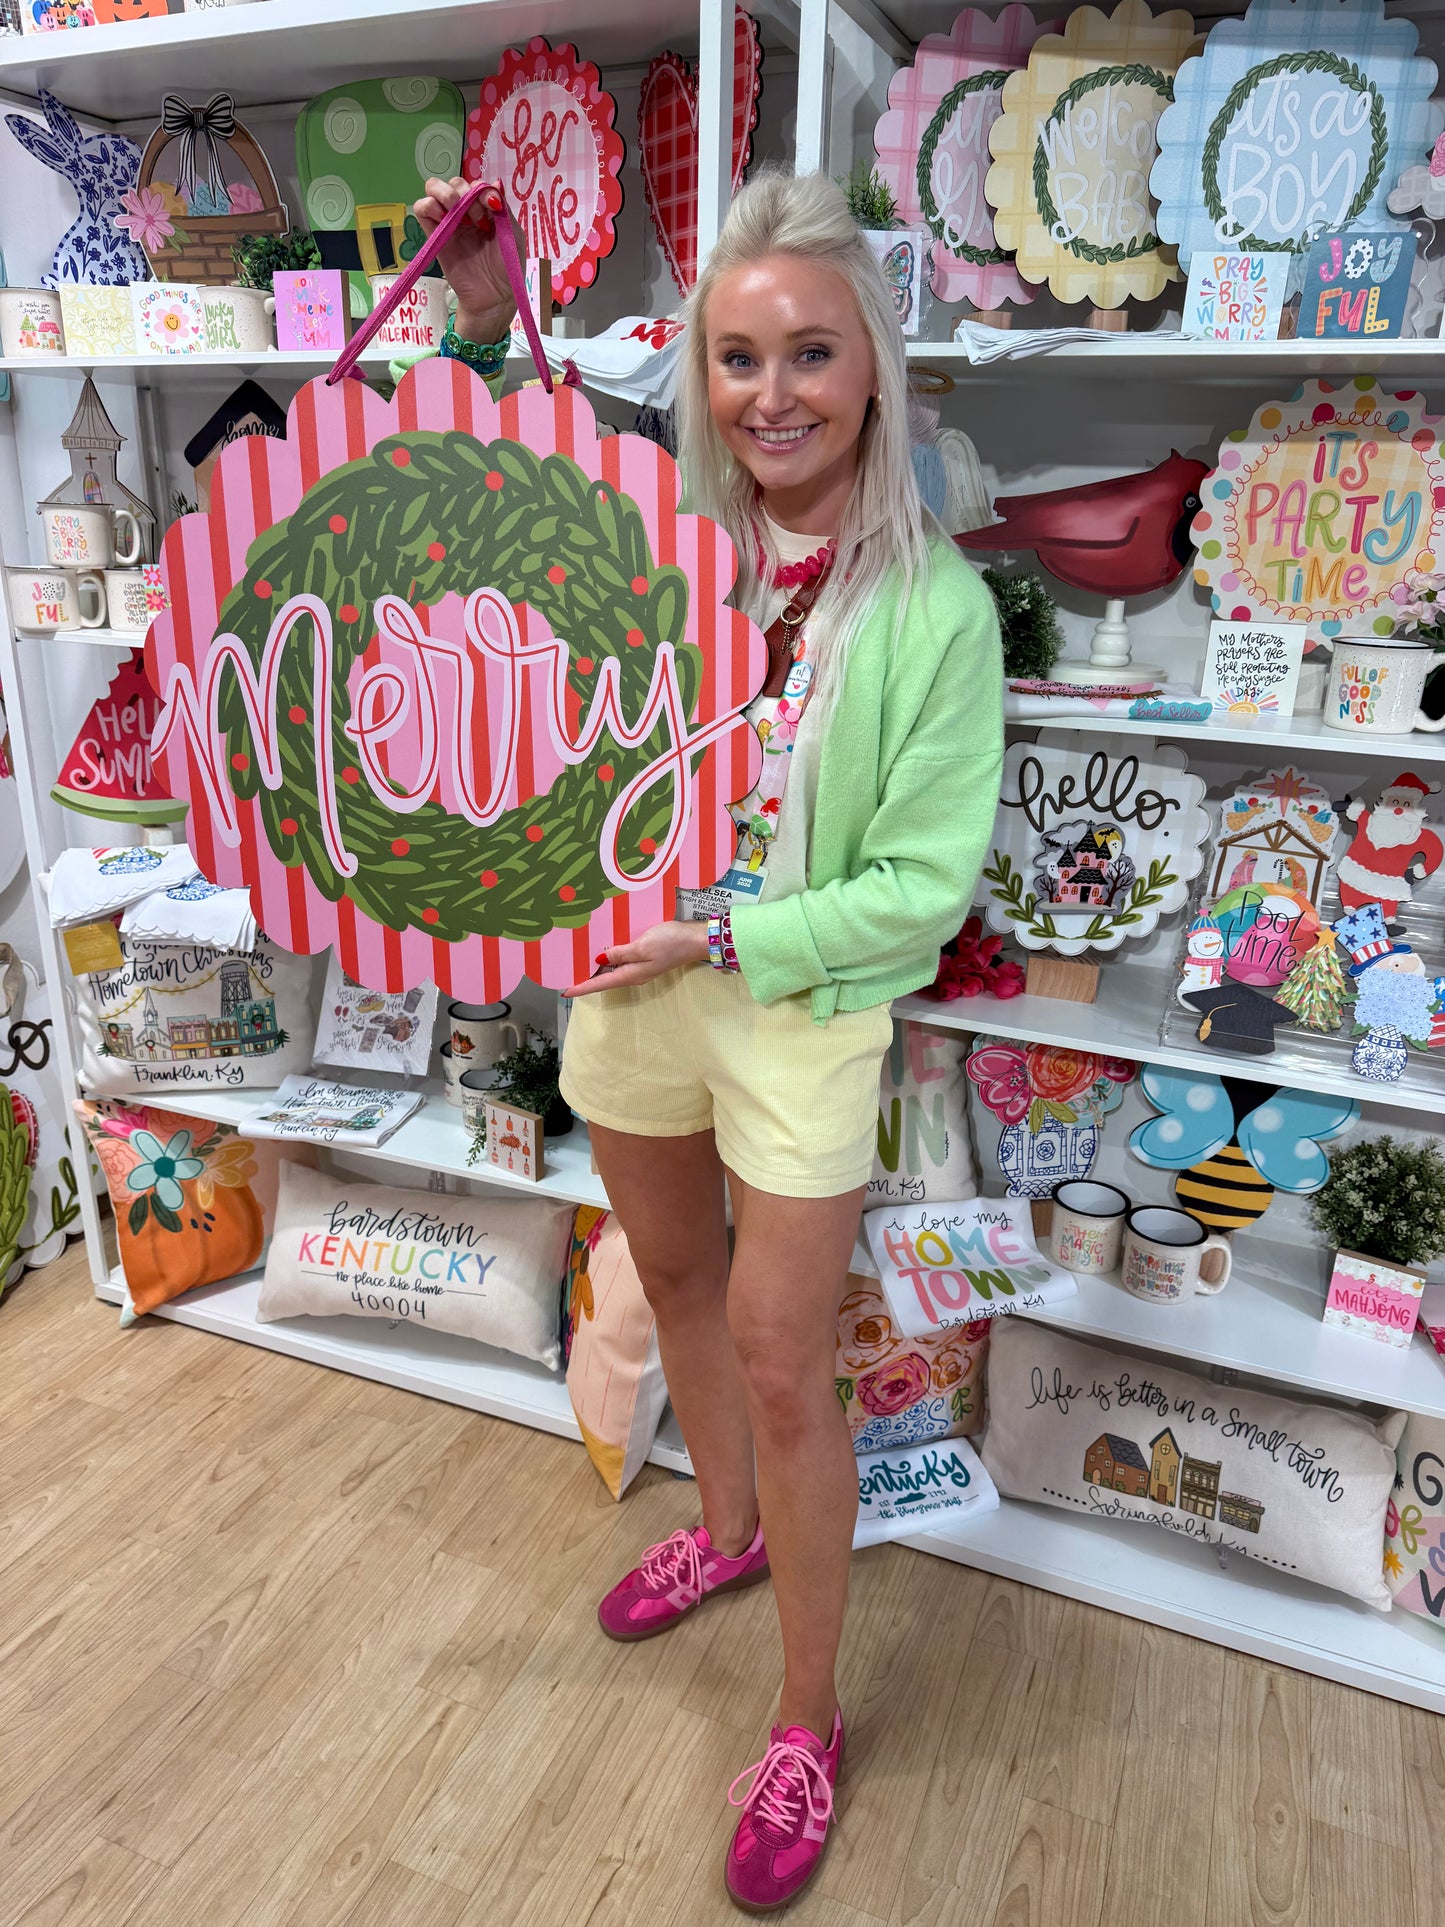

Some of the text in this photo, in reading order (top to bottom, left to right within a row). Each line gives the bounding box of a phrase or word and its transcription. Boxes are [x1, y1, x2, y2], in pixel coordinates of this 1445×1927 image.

[1309, 90, 1373, 140] a
[501, 98, 579, 201] be
[1215, 142, 1358, 245] BOY
[1050, 169, 1157, 244] BAB
[1213, 256, 1264, 281] PRAY
[1319, 237, 1403, 283] JOY
[139, 290, 160, 310] GOOD
[160, 288, 188, 304] THINGS
[1219, 280, 1249, 305] BIG
[400, 307, 421, 325] MY
[1197, 302, 1267, 327] WORRY
[1315, 286, 1389, 337] FUL
[54, 515, 80, 528] PRAY
[1245, 479, 1422, 566] PARTY
[53, 535, 87, 549] WORRY
[32, 581, 66, 601] JOY
[36, 602, 69, 624] FUL
[1339, 683, 1382, 702] GOOD
[151, 587, 748, 891] Merry
[677, 894, 698, 904] AVISH
[708, 901, 730, 911] LACHE
[691, 891, 727, 904] BOZEMAN
[692, 903, 720, 914] STRUNK
[215, 1062, 244, 1085] Ky
[323, 1200, 488, 1247] bardstown
[913, 1211, 965, 1232] love
[973, 1211, 1013, 1231] my
[883, 1226, 1030, 1268] HOME
[1061, 1234, 1103, 1255] MAGIC
[298, 1232, 497, 1285] KENTUCKY
[336, 1271, 445, 1296] no place like home
[897, 1264, 1051, 1326] TOWN
[351, 1291, 426, 1320] 40004
[1335, 1289, 1411, 1326] MAHJONG
[1025, 1367, 1083, 1414] life
[1086, 1380, 1113, 1411] is
[1114, 1373, 1169, 1417] better
[1174, 1396, 1197, 1423] in
[1201, 1407, 1219, 1426] a
[1285, 1442, 1344, 1502] town
[859, 1450, 971, 1505] entucky
